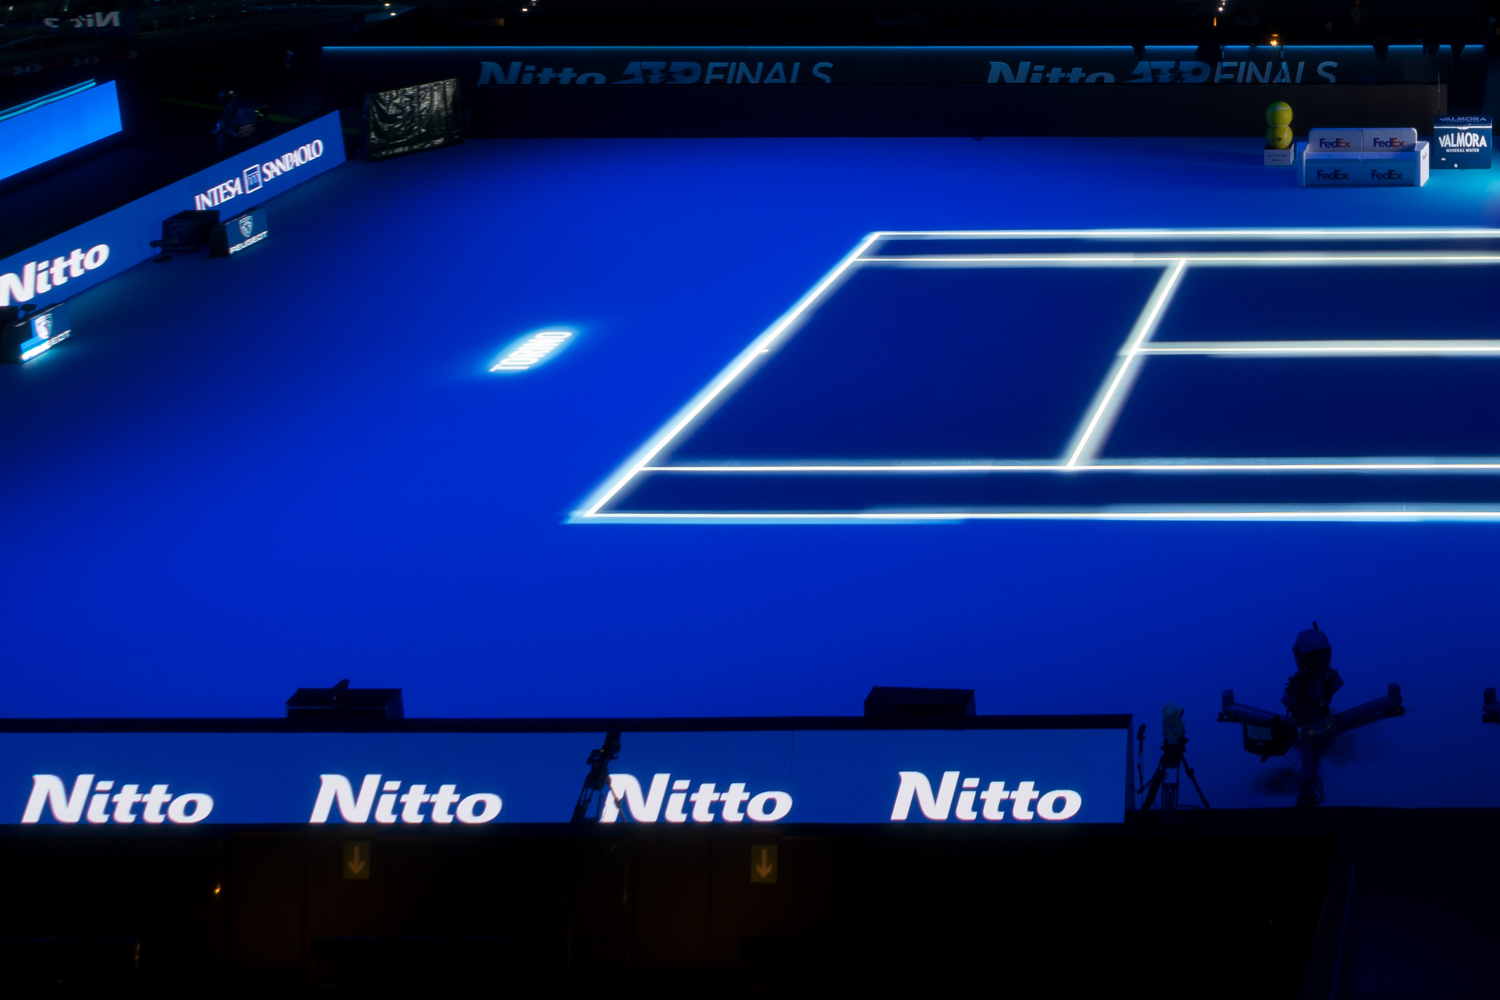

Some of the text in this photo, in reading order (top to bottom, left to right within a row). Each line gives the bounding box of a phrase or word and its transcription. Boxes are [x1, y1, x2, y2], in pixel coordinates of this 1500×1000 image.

[476, 61, 607, 87] Nitto
[986, 61, 1115, 83] Nitto
[1319, 138, 1351, 148] FedEx
[1373, 138, 1405, 148] FedEx
[1438, 132, 1488, 148] VALMORA
[194, 139, 324, 211] INTESA SANPAOLO
[1317, 169, 1349, 180] FedEx
[1371, 169, 1403, 180] FedEx
[0, 244, 110, 306] Nitto
[20, 774, 214, 823] Nitto
[309, 774, 502, 823] Nitto
[599, 773, 793, 823] Nitto
[890, 771, 1081, 821] Nitto
